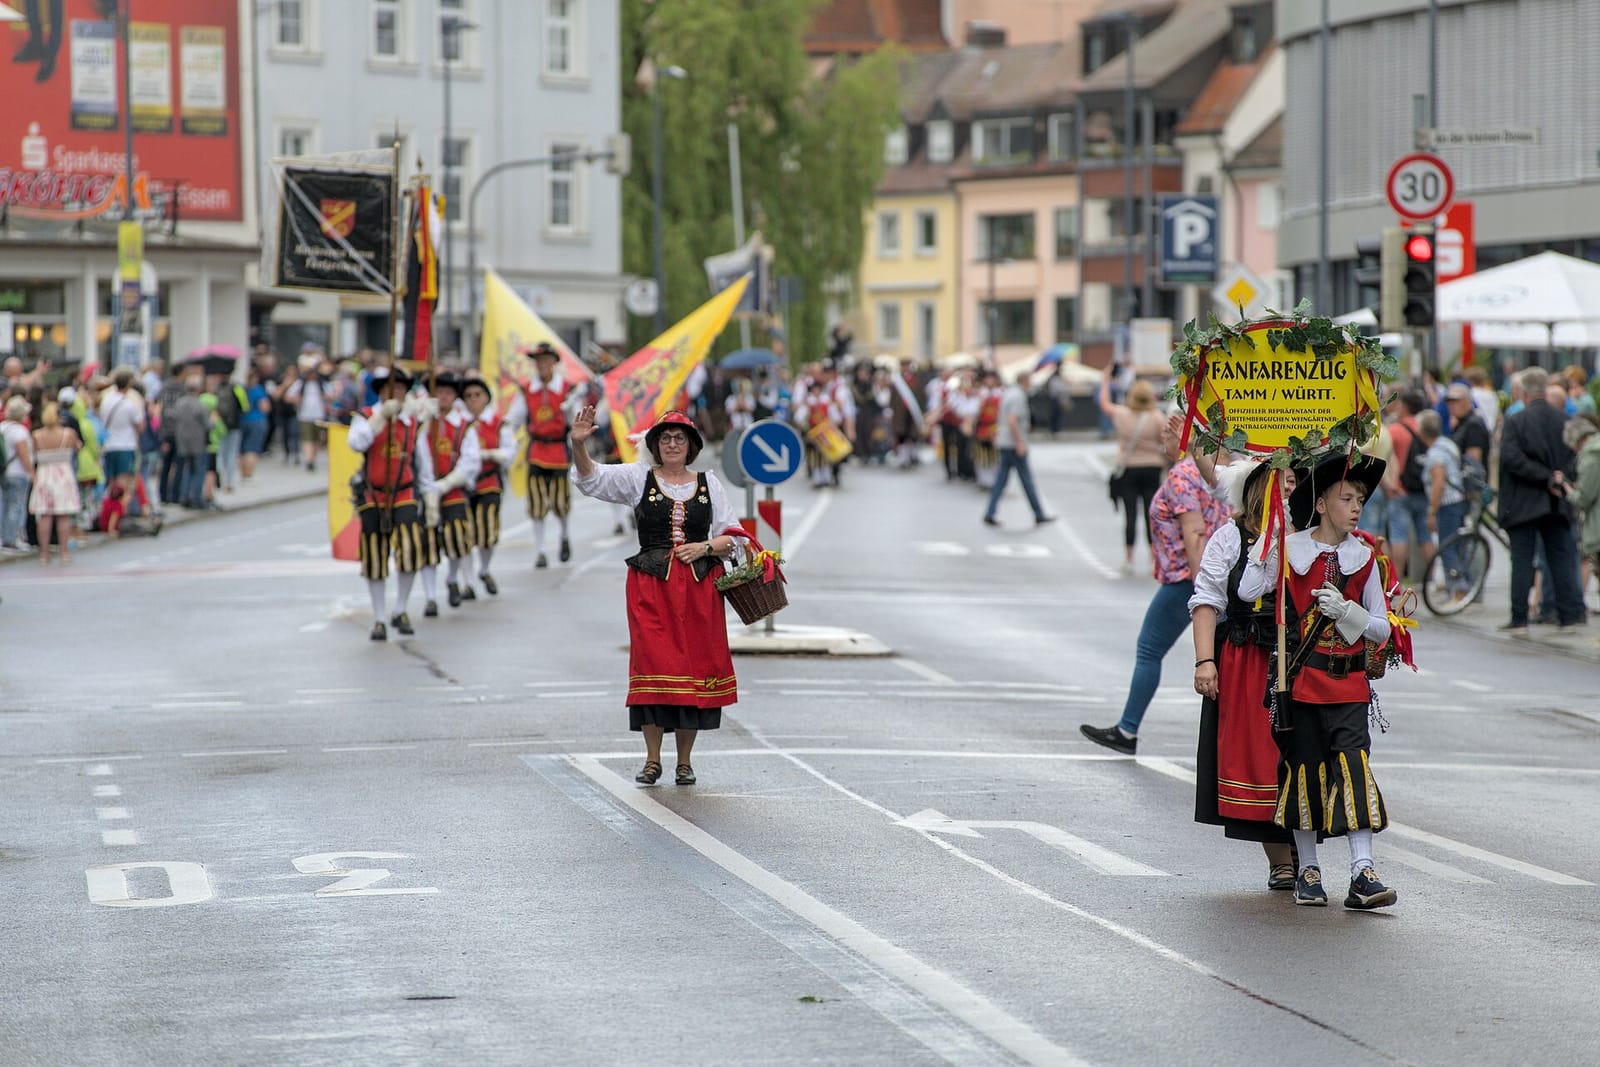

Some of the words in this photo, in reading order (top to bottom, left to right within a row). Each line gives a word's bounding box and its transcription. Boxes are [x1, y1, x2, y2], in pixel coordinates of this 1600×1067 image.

[1401, 172, 1440, 202] 30
[1173, 212, 1210, 258] P
[1211, 360, 1347, 380] FANFARENZUG
[1224, 388, 1267, 400] TAMM
[1281, 385, 1336, 400] WÜRTT.
[1226, 414, 1290, 422] ÜRTTEMBERGISCHEN
[1228, 407, 1267, 415] OFFIZIELLER
[1268, 406, 1316, 415] REPRÄSENTANT
